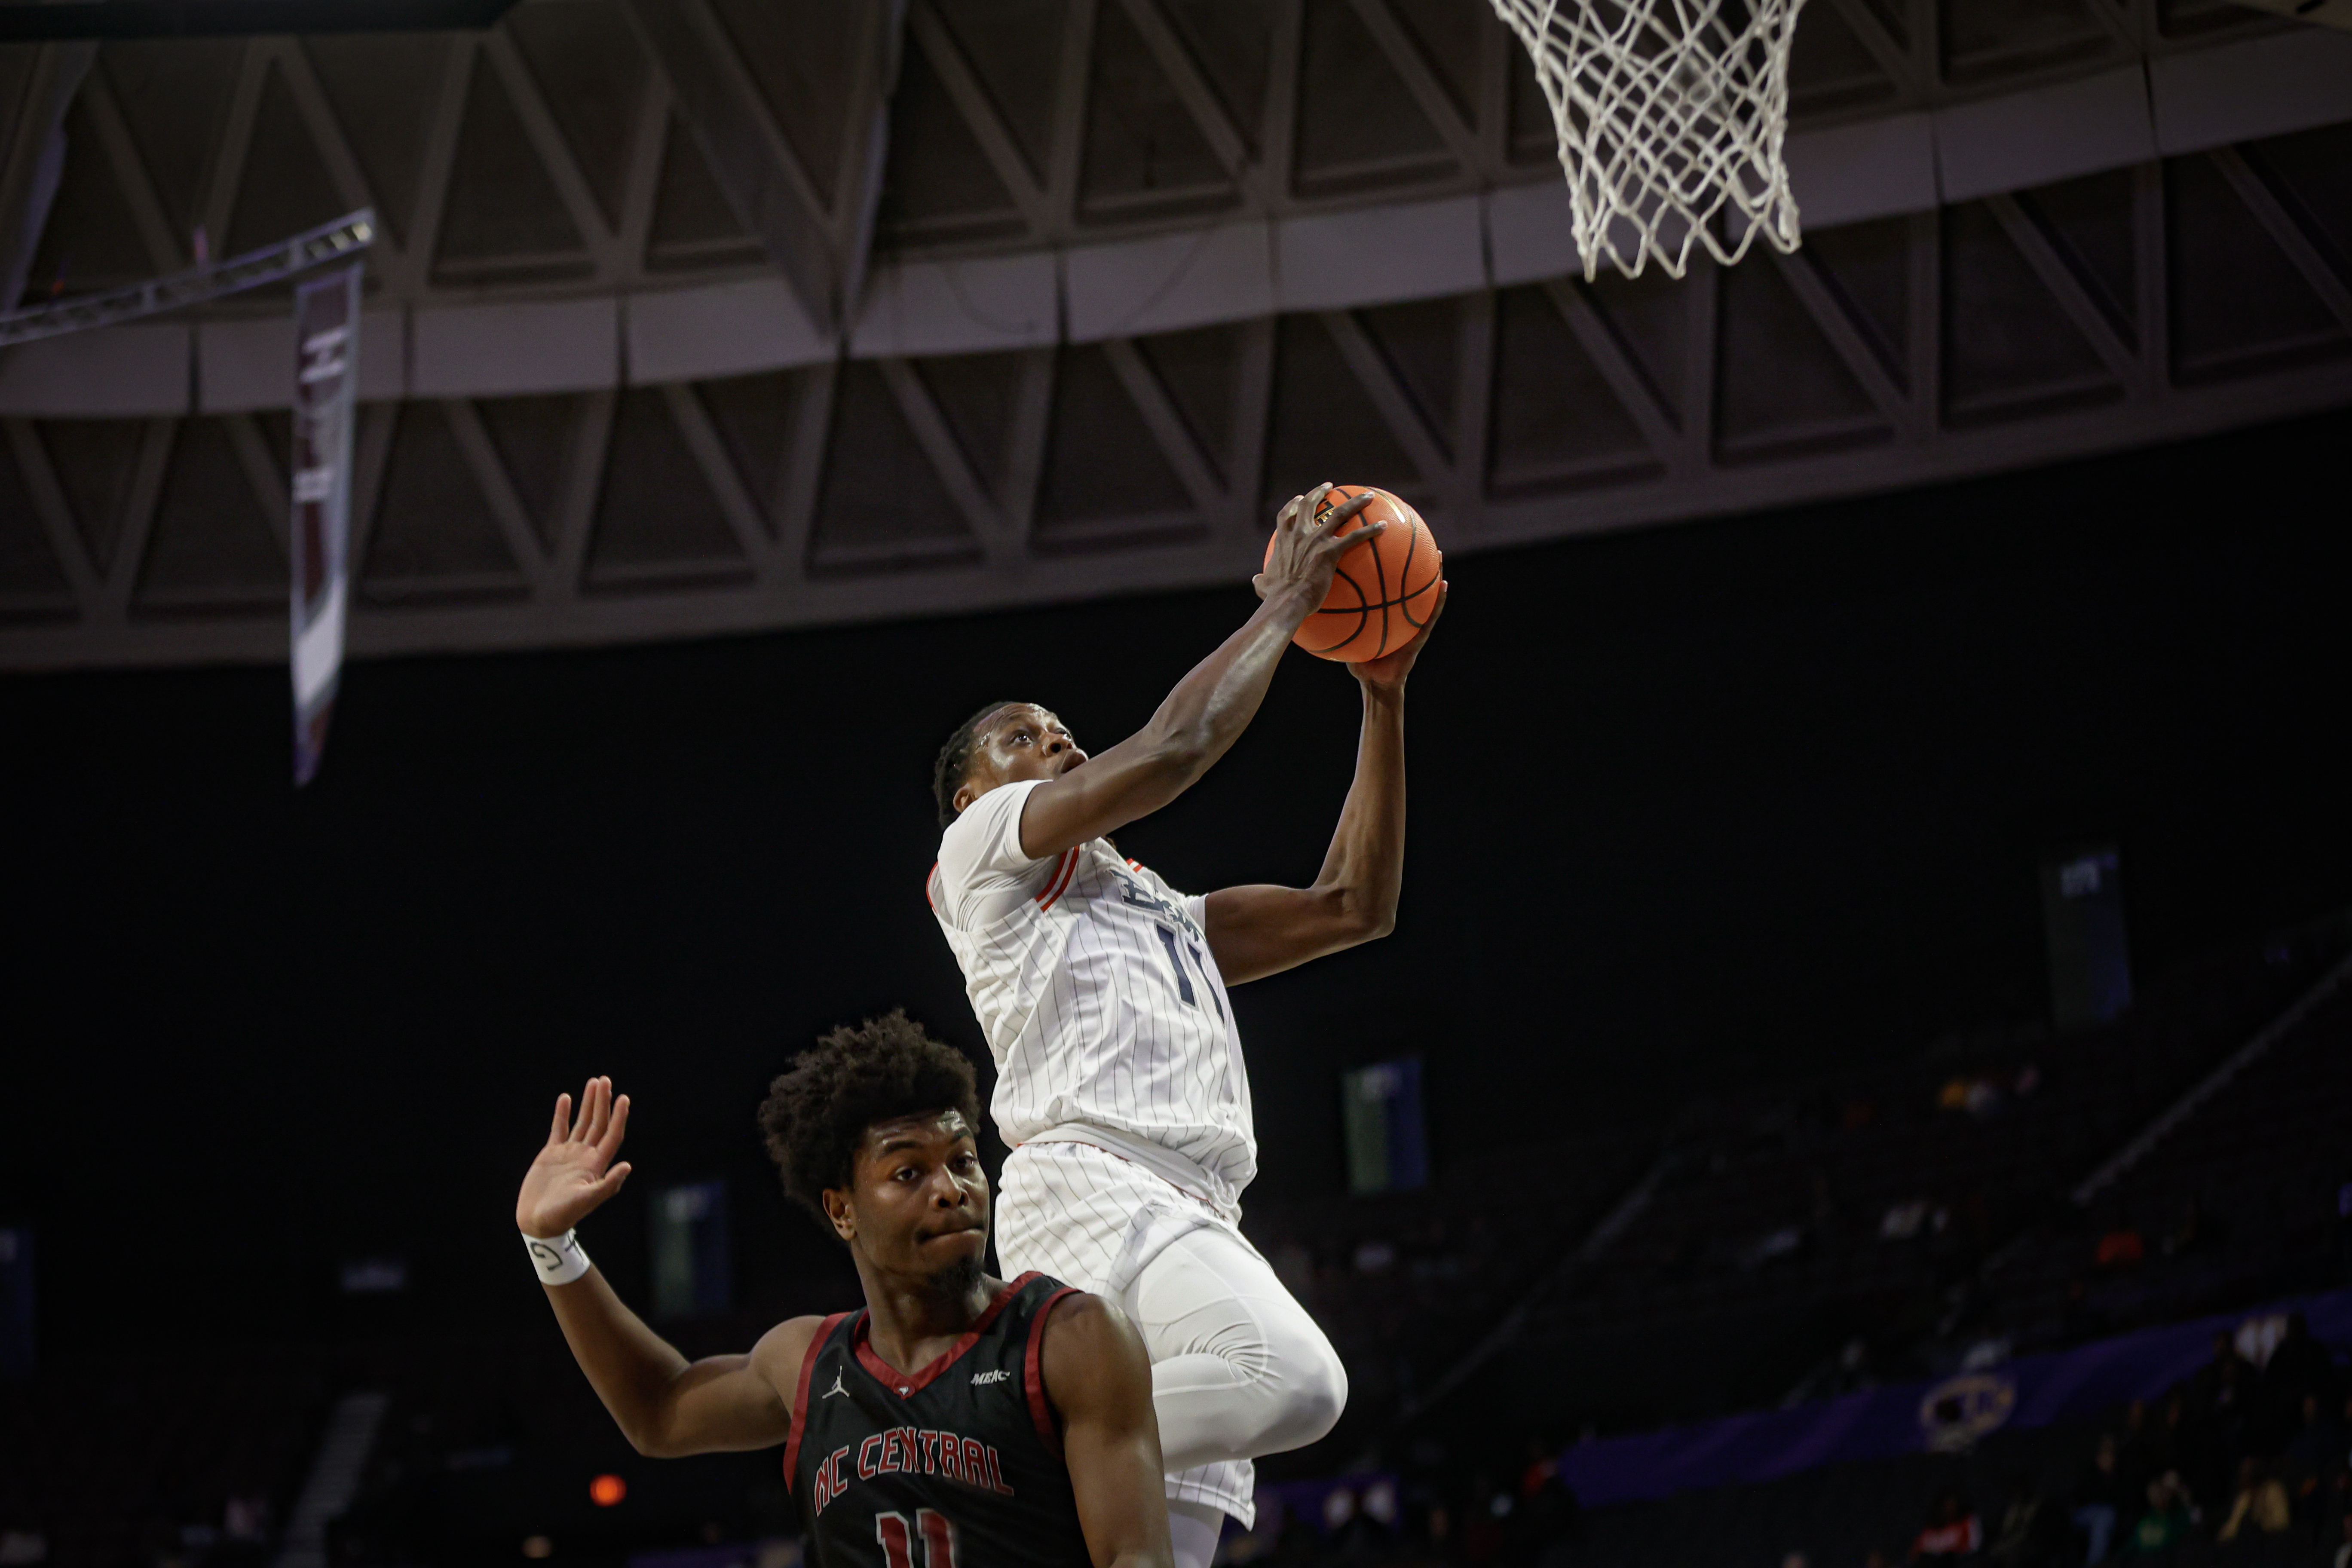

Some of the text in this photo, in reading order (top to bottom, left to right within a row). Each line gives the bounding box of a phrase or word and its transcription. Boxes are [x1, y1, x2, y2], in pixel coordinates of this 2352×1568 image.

[1154, 919, 1226, 1029] 11
[970, 1369, 1011, 1386] MEAC
[814, 1426, 1014, 1517] NC CENTRAL
[875, 1507, 957, 1568] 11
